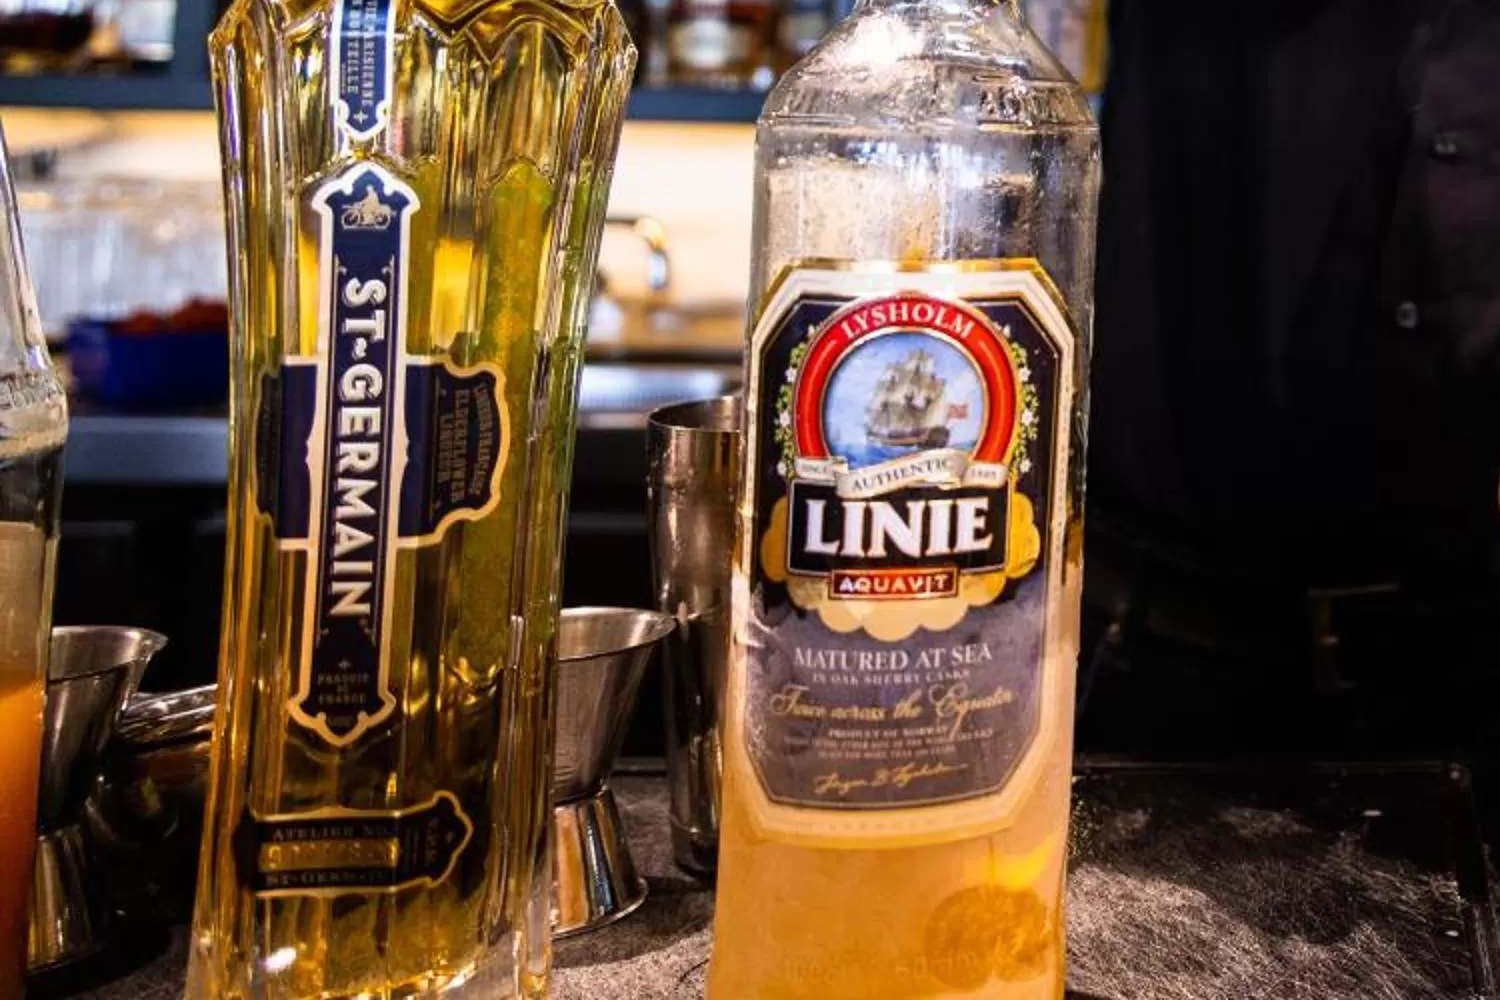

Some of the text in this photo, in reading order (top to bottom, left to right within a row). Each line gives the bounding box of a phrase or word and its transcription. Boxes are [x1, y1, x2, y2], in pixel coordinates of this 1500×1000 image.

[841, 302, 976, 339] LYSHOLM
[851, 457, 952, 493] AUTHENTIC
[803, 497, 994, 558] LINIE
[838, 573, 949, 597] AQUAVIT
[794, 642, 993, 671] MATURED AT SEA
